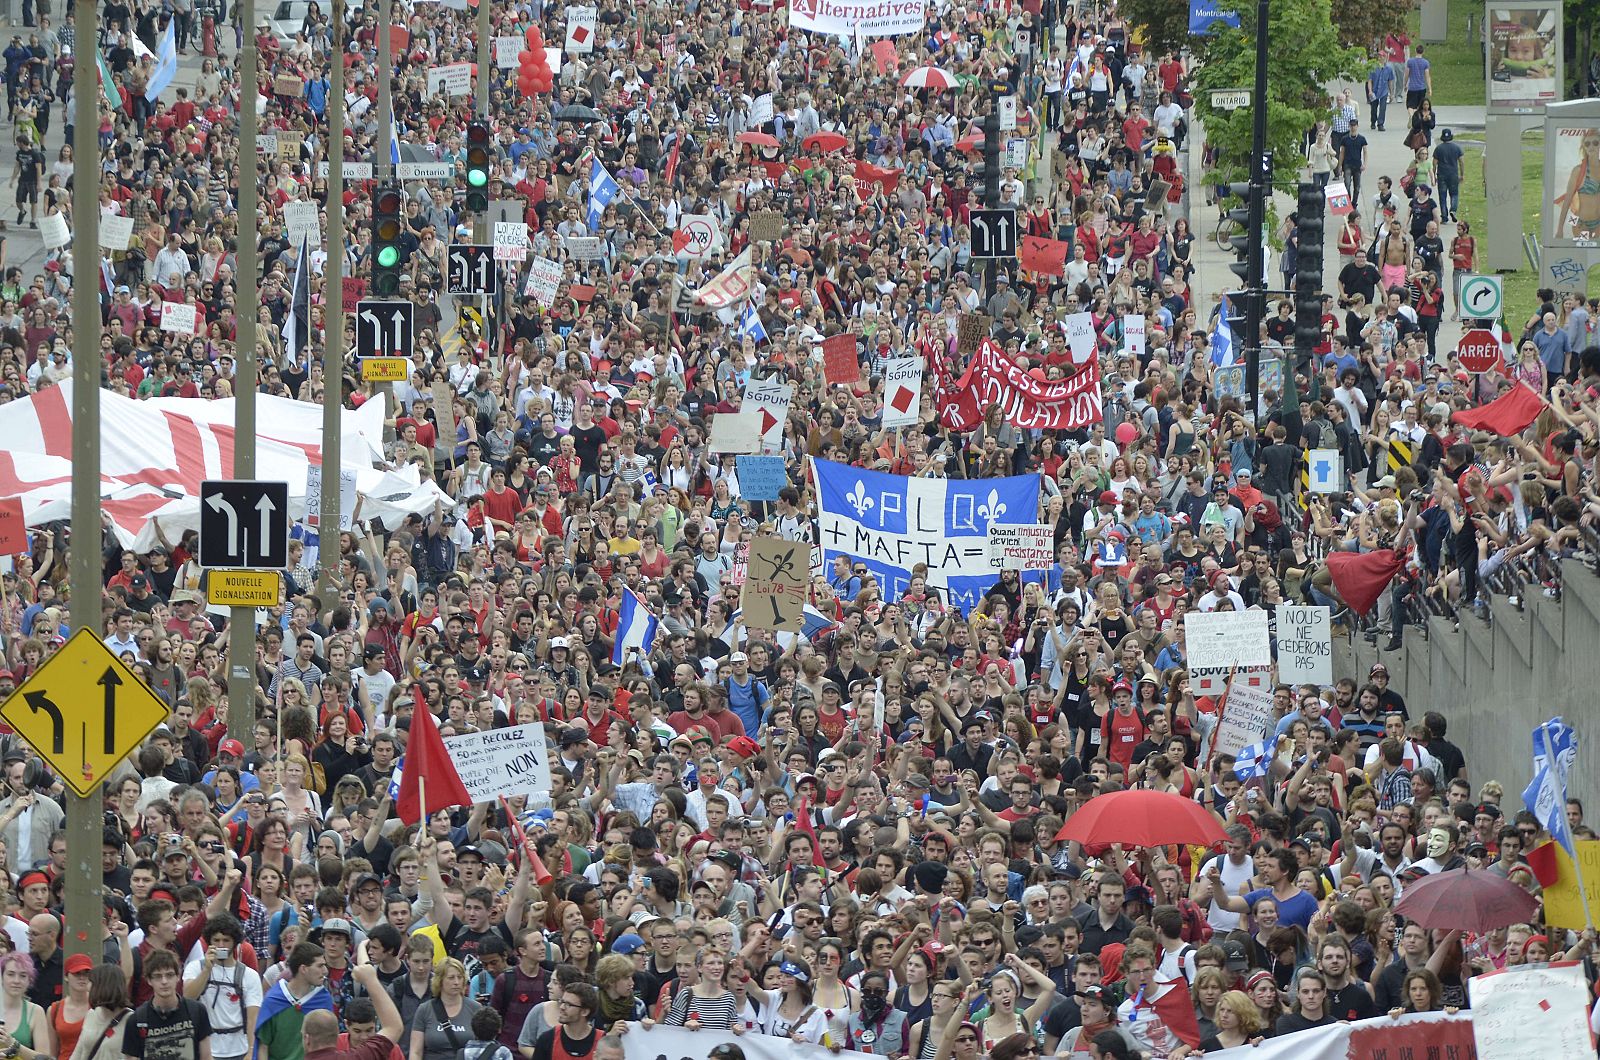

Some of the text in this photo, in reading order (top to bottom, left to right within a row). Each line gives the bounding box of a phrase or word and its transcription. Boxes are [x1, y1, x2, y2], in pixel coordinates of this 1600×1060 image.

[861, 20, 890, 28] olidarité
[1216, 97, 1246, 105] ONTARIO
[414, 167, 446, 177] Ontario
[1459, 342, 1498, 358] ARRÊT
[888, 369, 922, 381] SGPUM
[747, 391, 789, 406] SGPUM
[989, 527, 1016, 536] Quand
[1003, 546, 1053, 560] résistance
[989, 557, 1005, 568] est
[1024, 558, 1054, 569] devoir
[226, 577, 263, 587] NOUVELLE
[756, 582, 785, 594] Loi 78
[215, 589, 273, 601] SIGNALISATION
[1285, 609, 1322, 625] NOUS
[1296, 625, 1313, 640] NE
[1277, 638, 1331, 657] CÉDERONS
[1294, 655, 1316, 670] PAS
[481, 729, 525, 745] RECULEZ
[504, 750, 540, 779] NON
[436, 1024, 466, 1032] UAM
